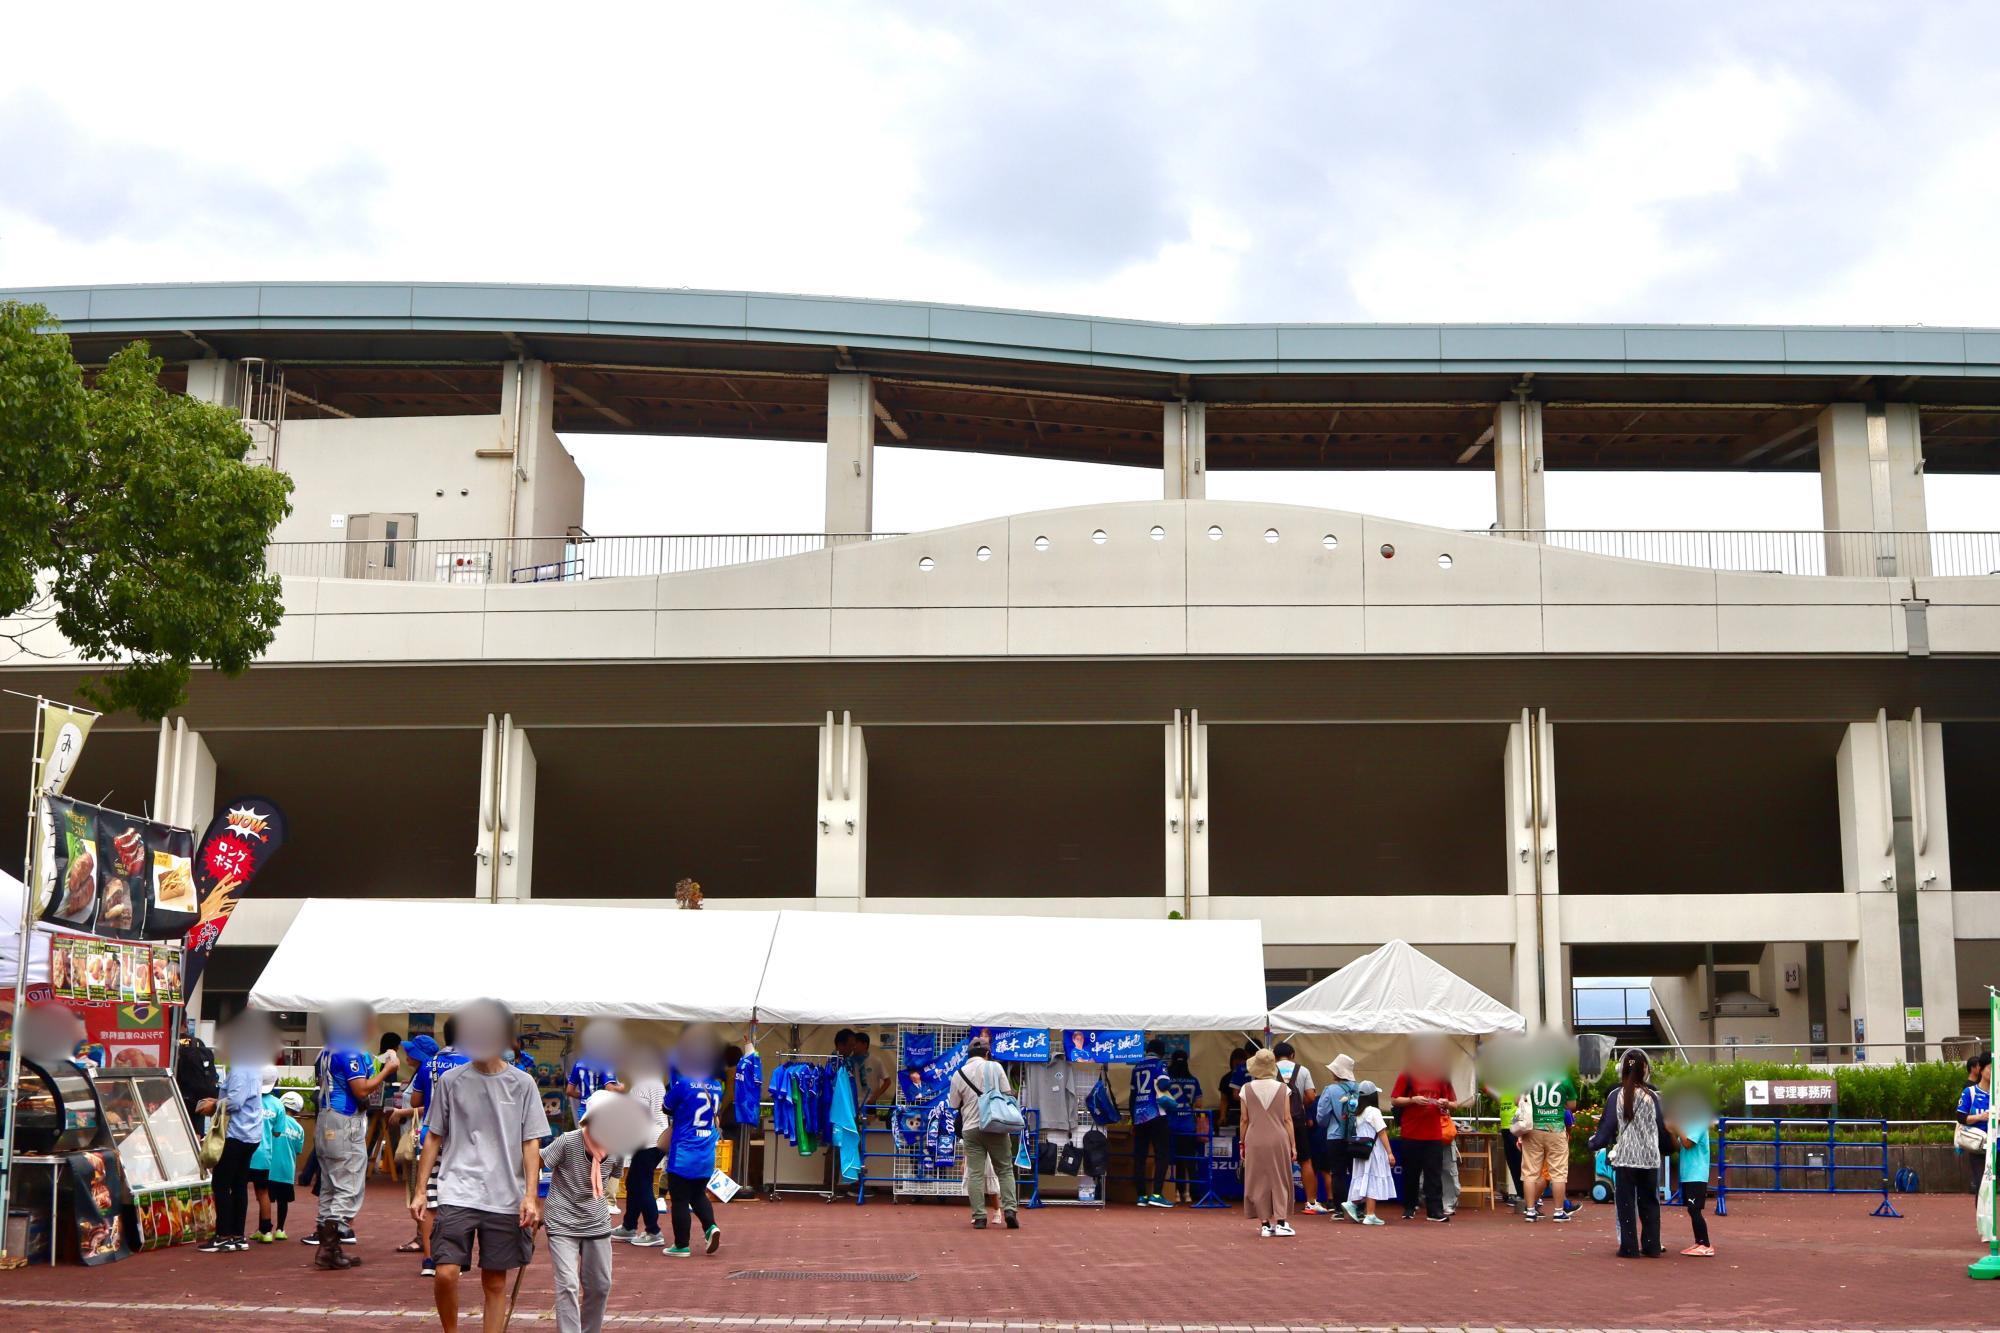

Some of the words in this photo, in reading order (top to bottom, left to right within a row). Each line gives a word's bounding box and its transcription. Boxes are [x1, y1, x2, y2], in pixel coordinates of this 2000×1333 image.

[227, 813, 268, 834] WOW
[218, 841, 248, 862] ロング
[213, 854, 242, 875] ポテト
[1089, 1032, 1096, 1043] 9
[1091, 1038, 1115, 1056] 中野
[425, 1061, 453, 1069] SUUGA
[1136, 1070, 1151, 1094] 12
[1773, 1085, 1832, 1099] 管理事務所
[1532, 1081, 1562, 1107] 06
[693, 1091, 719, 1127] 21
[1211, 1162, 1239, 1170] azu
